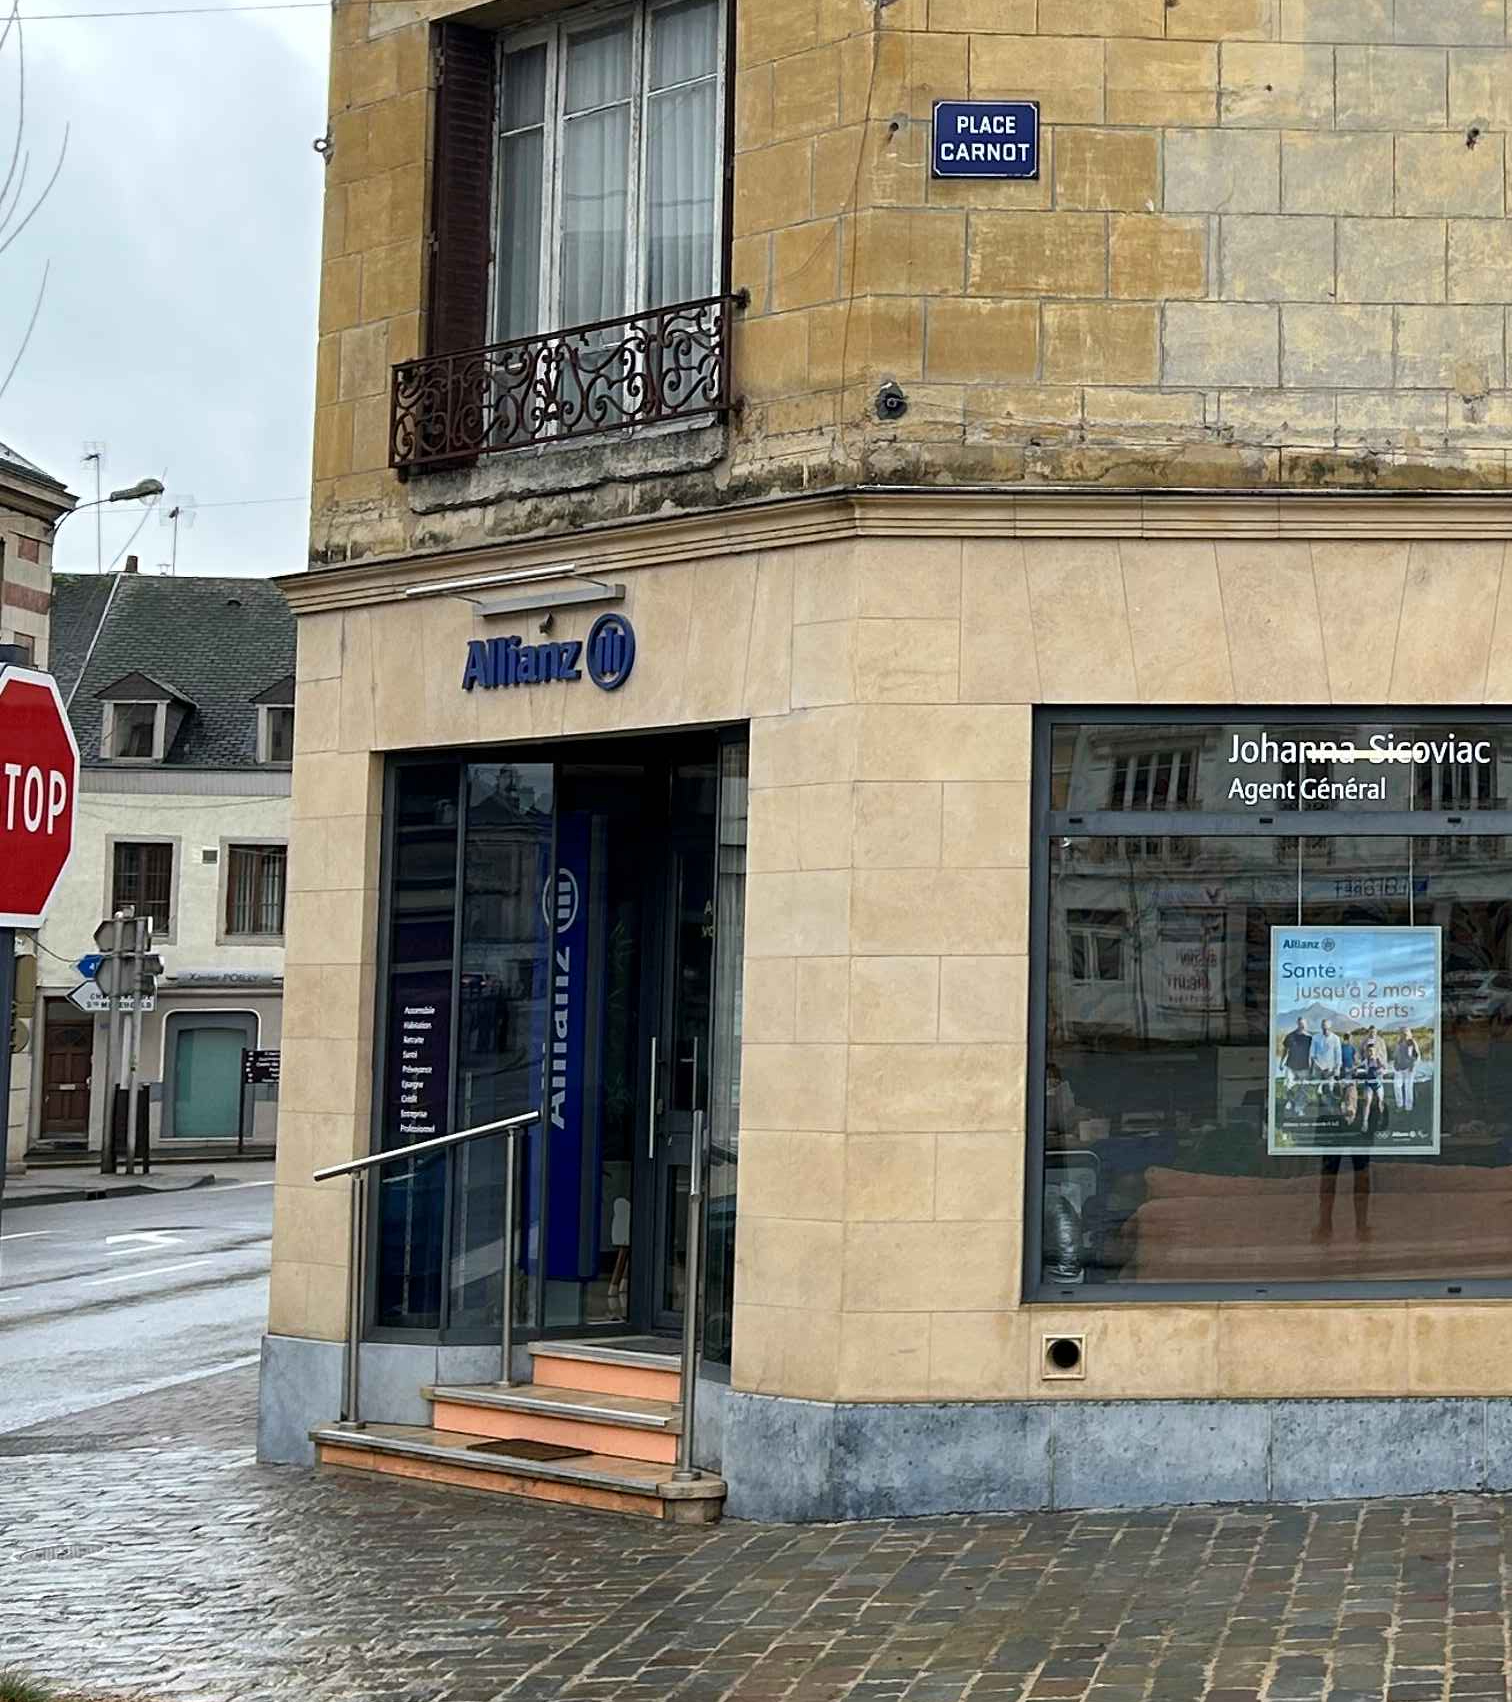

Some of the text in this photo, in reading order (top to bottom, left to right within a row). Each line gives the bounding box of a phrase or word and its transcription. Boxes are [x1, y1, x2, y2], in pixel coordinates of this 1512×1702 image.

[957, 116, 1016, 134] PLACE
[941, 143, 1030, 161] CARNOT
[462, 635, 583, 692] Allianz
[1228, 732, 1491, 764] Johanna Sicoviac
[4, 763, 67, 834] TOP
[1228, 776, 1386, 805] Agent Général
[1283, 938, 1320, 949] Allianz
[1295, 981, 1426, 1002] jusqu'à 2 mois
